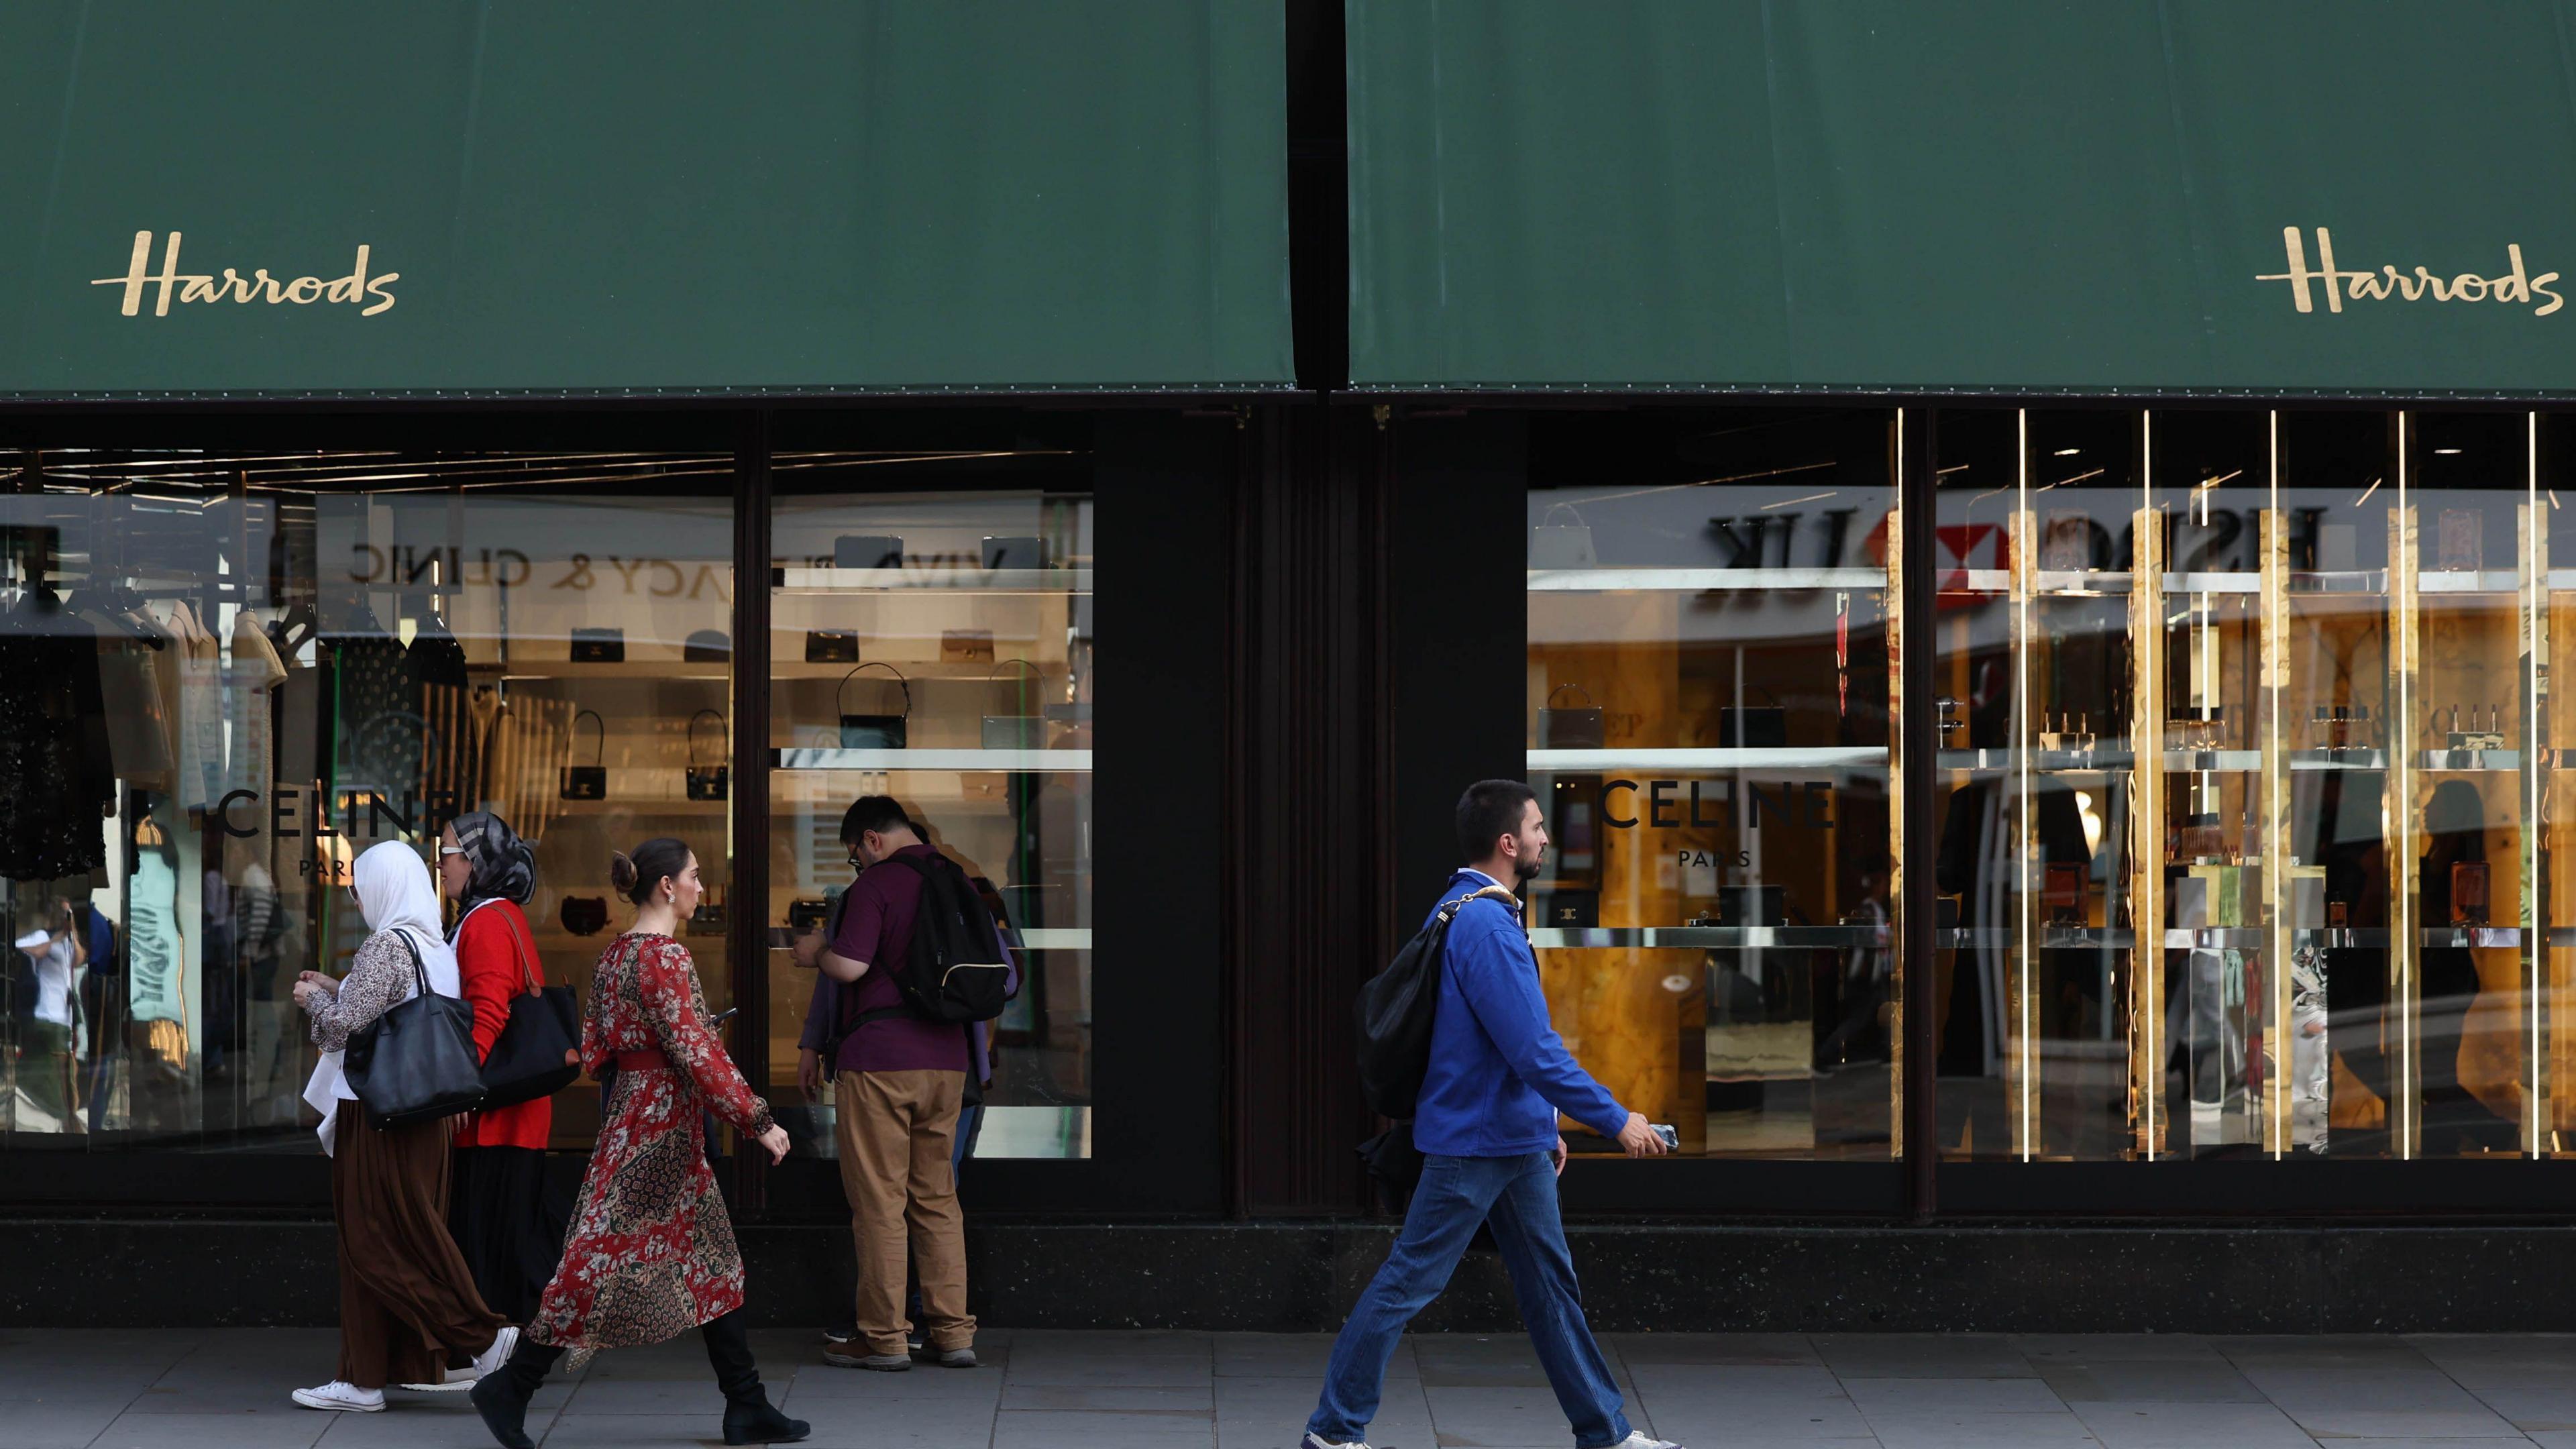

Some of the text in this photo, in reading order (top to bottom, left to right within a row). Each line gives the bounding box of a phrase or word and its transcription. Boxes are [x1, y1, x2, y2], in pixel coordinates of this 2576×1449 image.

[91, 231, 399, 316] Harrods
[2255, 227, 2564, 316] Harrods
[218, 789, 453, 839] CELINE
[1599, 780, 1834, 829] CELINE
[299, 860, 355, 876] PARI
